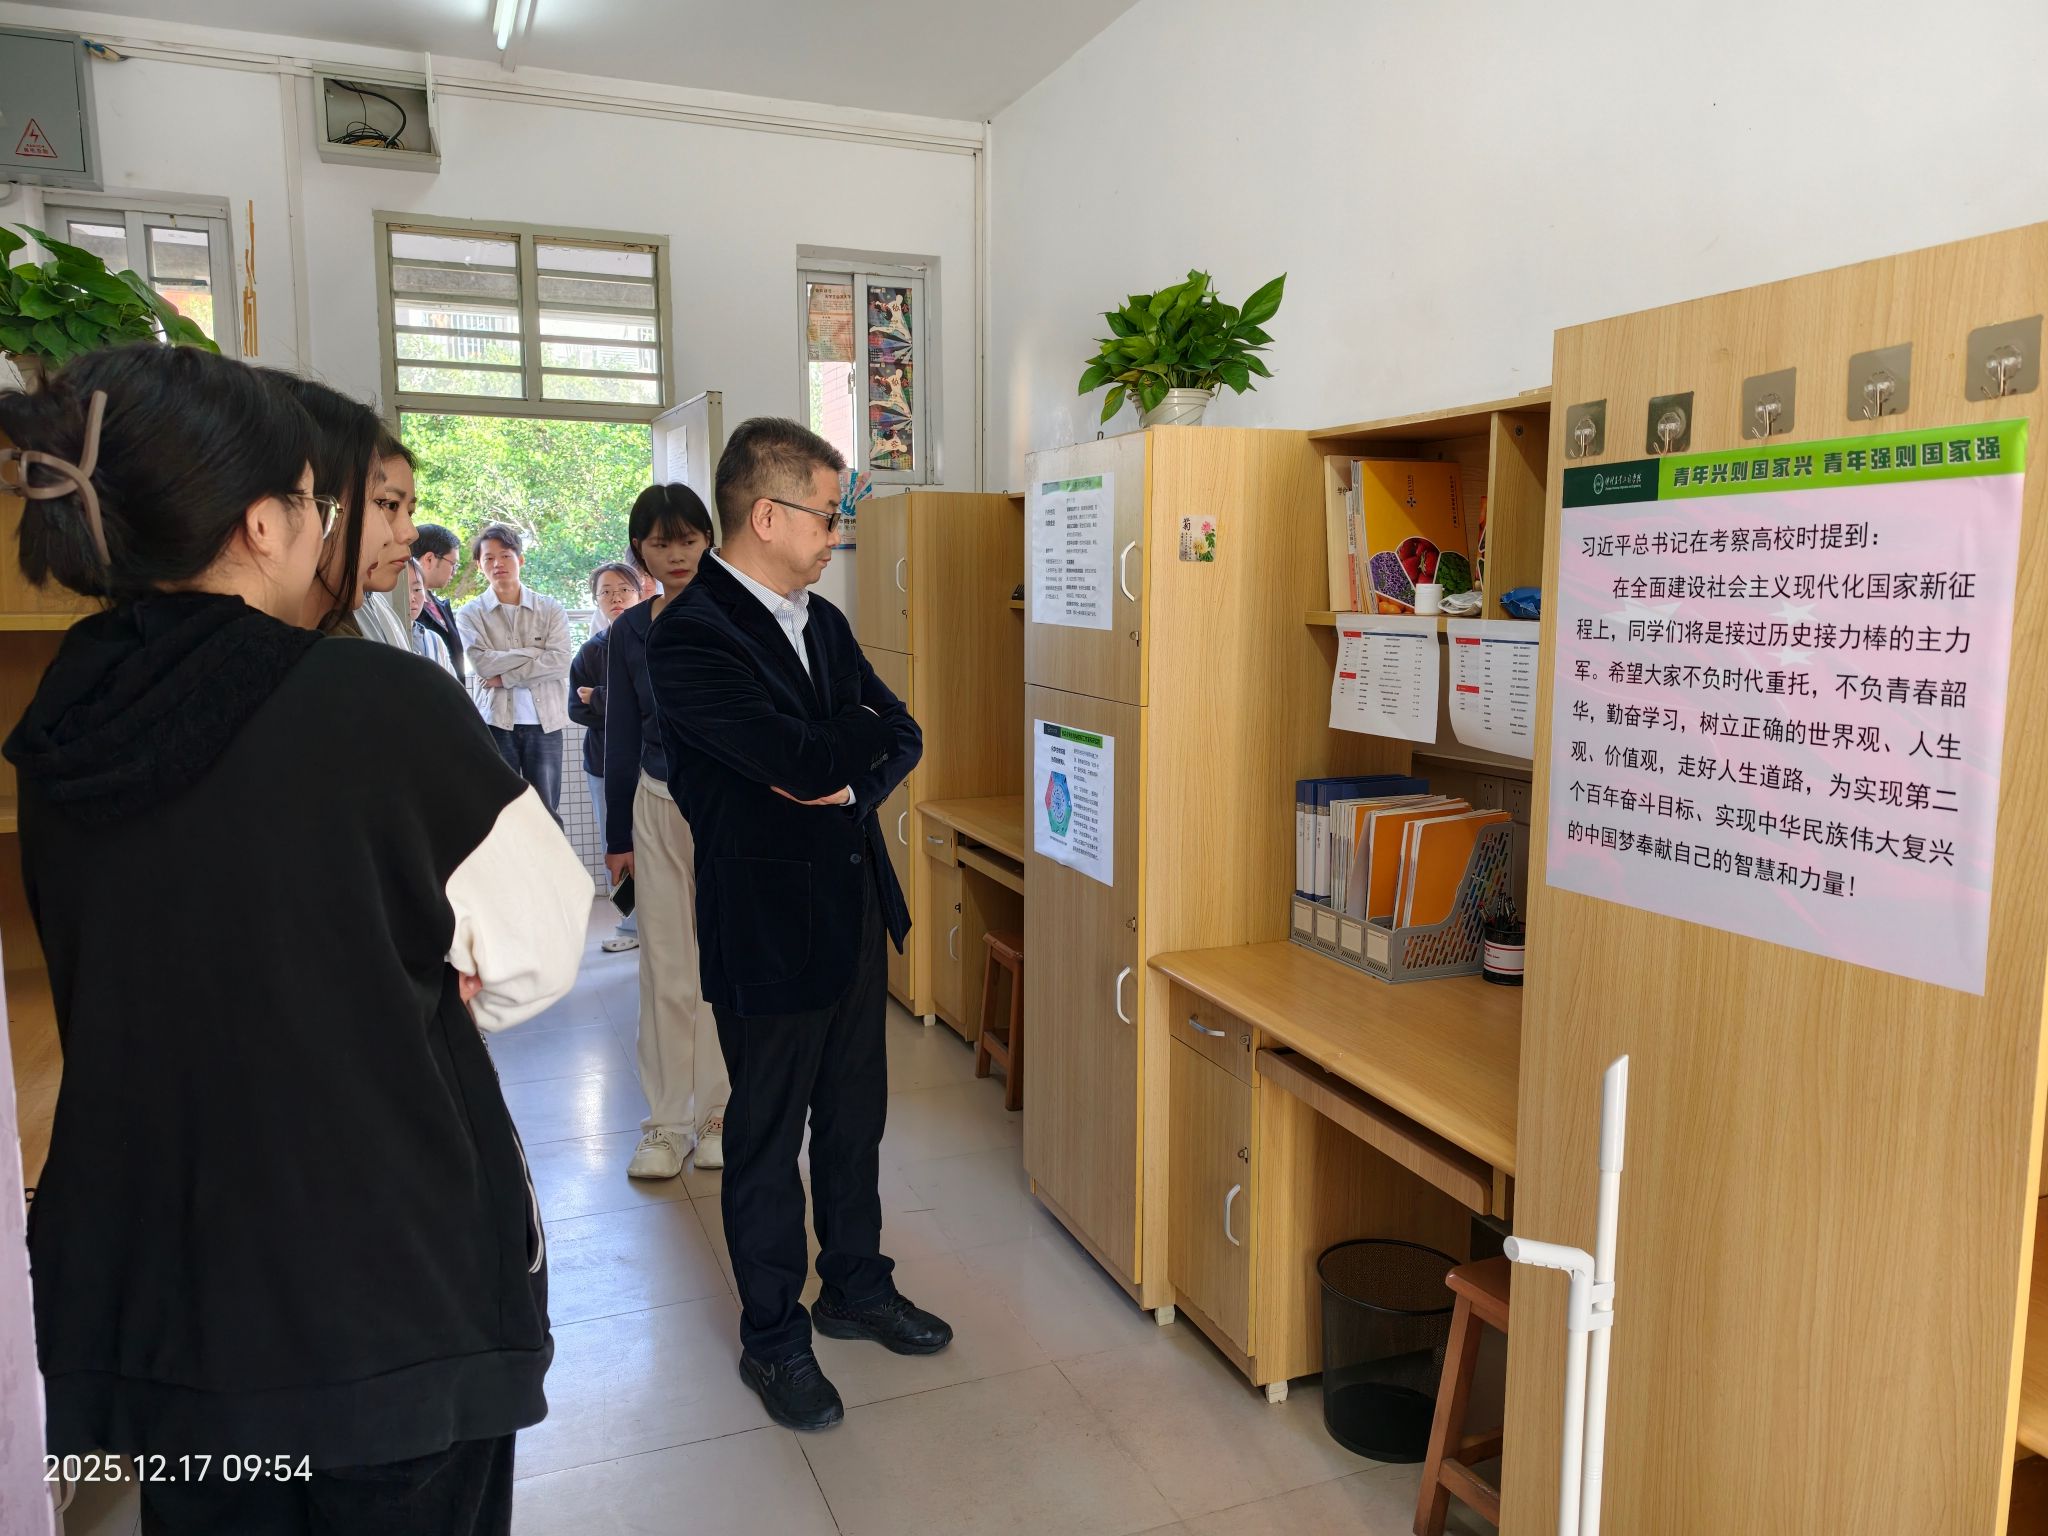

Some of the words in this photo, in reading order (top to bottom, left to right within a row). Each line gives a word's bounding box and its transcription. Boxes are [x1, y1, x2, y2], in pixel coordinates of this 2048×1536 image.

[1673, 454, 1813, 487] 青年兴则国家兴
[1822, 436, 2000, 474] 青年强则国家强
[1582, 521, 1878, 557] 习近平总书记在考察高校时提到：
[1612, 571, 1976, 600] 在全面建设社会主义现代化国家新征
[1576, 618, 1970, 653] 程上，同学们将是接过历史接力棒的主力
[1574, 660, 1967, 708] 军。希望大家不负时代重托，不负青春韶
[1572, 699, 1961, 760] 华，勤奋学习，树立正确的世界观、人生
[1571, 740, 1958, 812] 观、价值观，走好人生道路，为实现第二
[1569, 780, 1955, 867] 个百年奋斗目标、实现中华民族伟大复兴
[1568, 819, 1856, 897] 的中国梦奉献自己的智慧和力量！
